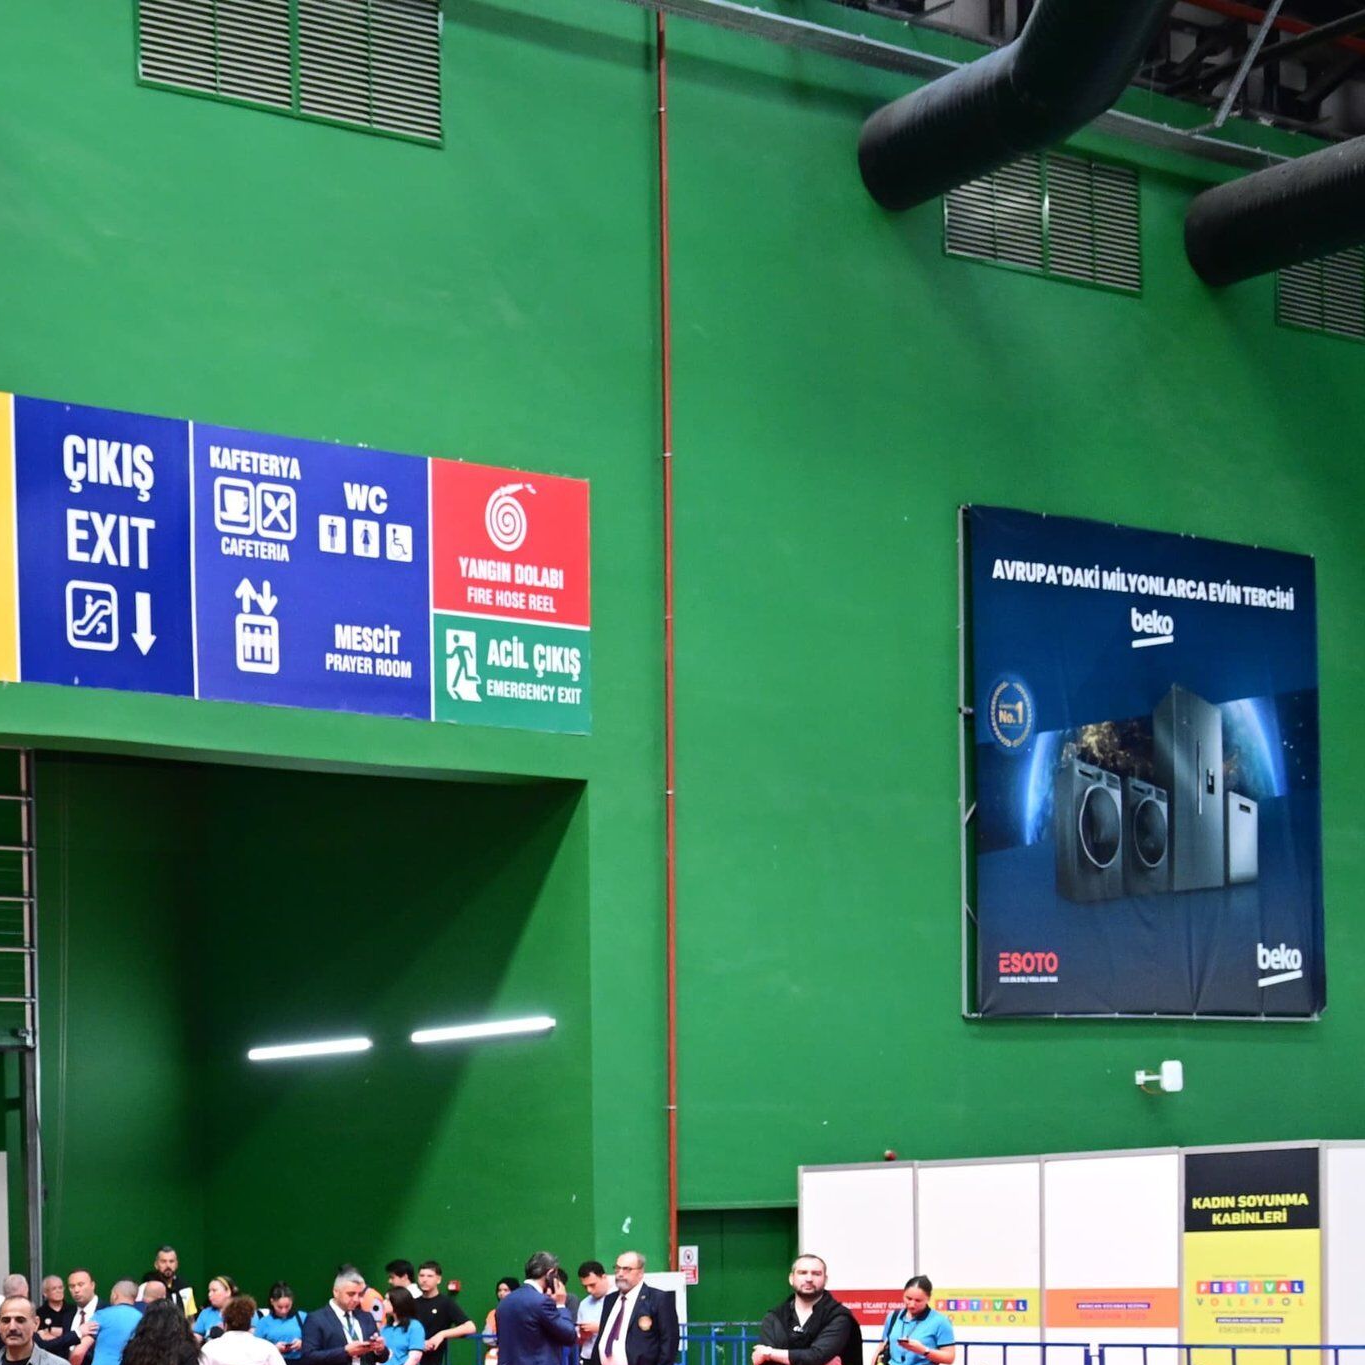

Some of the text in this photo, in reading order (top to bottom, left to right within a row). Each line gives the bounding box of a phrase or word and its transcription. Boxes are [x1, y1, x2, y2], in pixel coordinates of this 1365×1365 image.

[62, 434, 155, 502] ÇIKIŞ
[209, 445, 301, 480] KAFETERYA
[343, 482, 388, 514] WC
[66, 508, 156, 570] EXIT
[221, 536, 290, 562] CAFETERIA
[458, 556, 564, 589] YANGIN DOLABI
[992, 559, 1294, 611] AVRUPA'DAKİ MİLYONLARCA EVİN TERCİHİ
[467, 586, 556, 613] FIRE HOSE REEL
[1131, 607, 1174, 636] beko
[334, 623, 401, 655] MESCİT
[325, 653, 412, 678] PRAYER ROOM
[487, 635, 581, 681] ACİL ÇIKIŞ
[486, 679, 582, 704] EMERGENCY EXIT
[999, 951, 1059, 974] ESOTO
[1257, 943, 1302, 971] beko
[1192, 1193, 1309, 1209] KADIN SOYUNMA
[1212, 1208, 1287, 1225] KABİNLERİ
